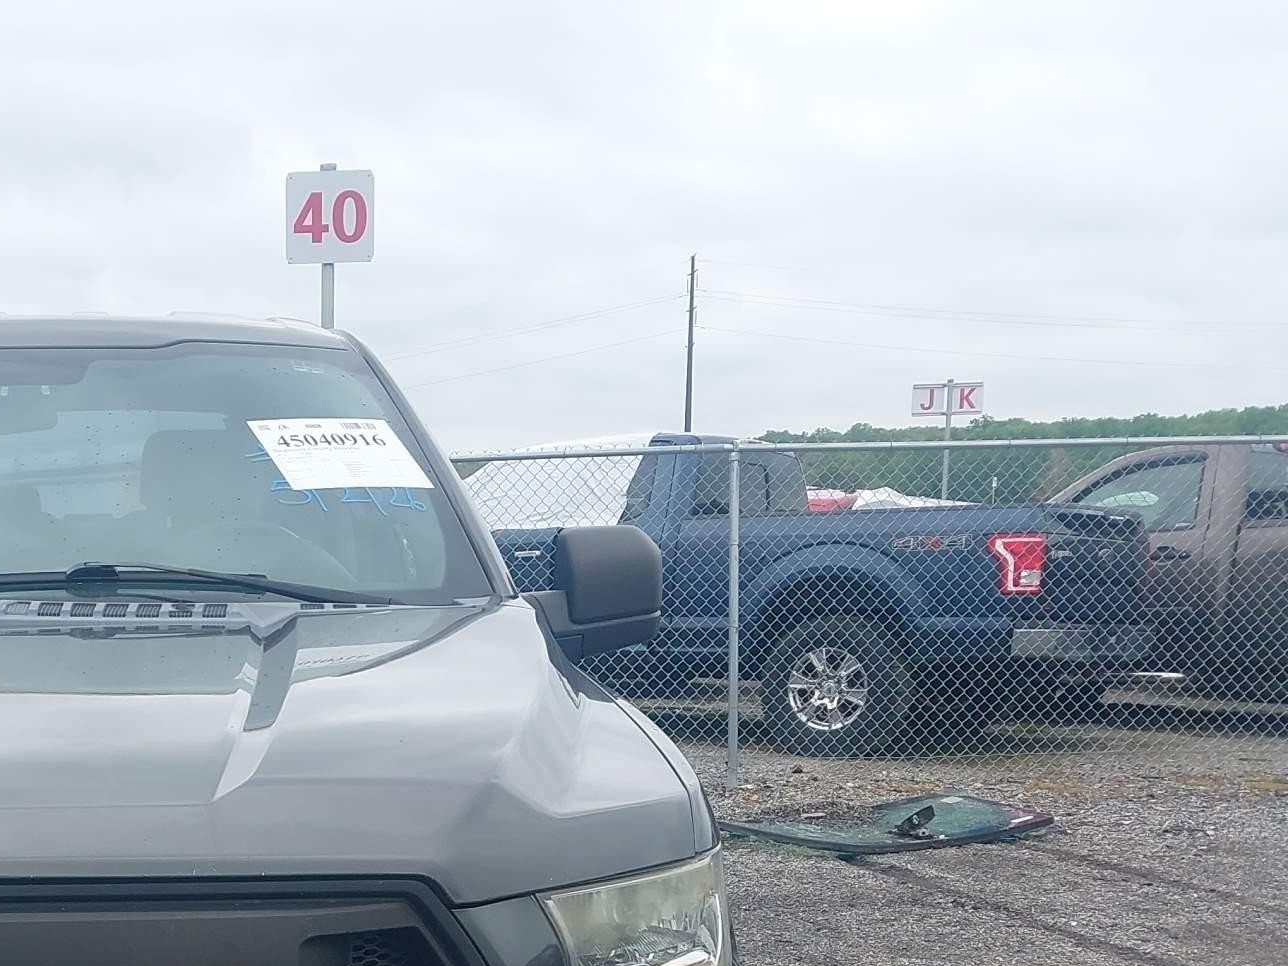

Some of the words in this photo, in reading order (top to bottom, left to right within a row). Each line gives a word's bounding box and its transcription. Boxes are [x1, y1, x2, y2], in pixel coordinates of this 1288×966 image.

[293, 190, 368, 244] 40
[919, 388, 935, 411] J
[959, 387, 976, 410] K
[277, 433, 386, 447] 45040916
